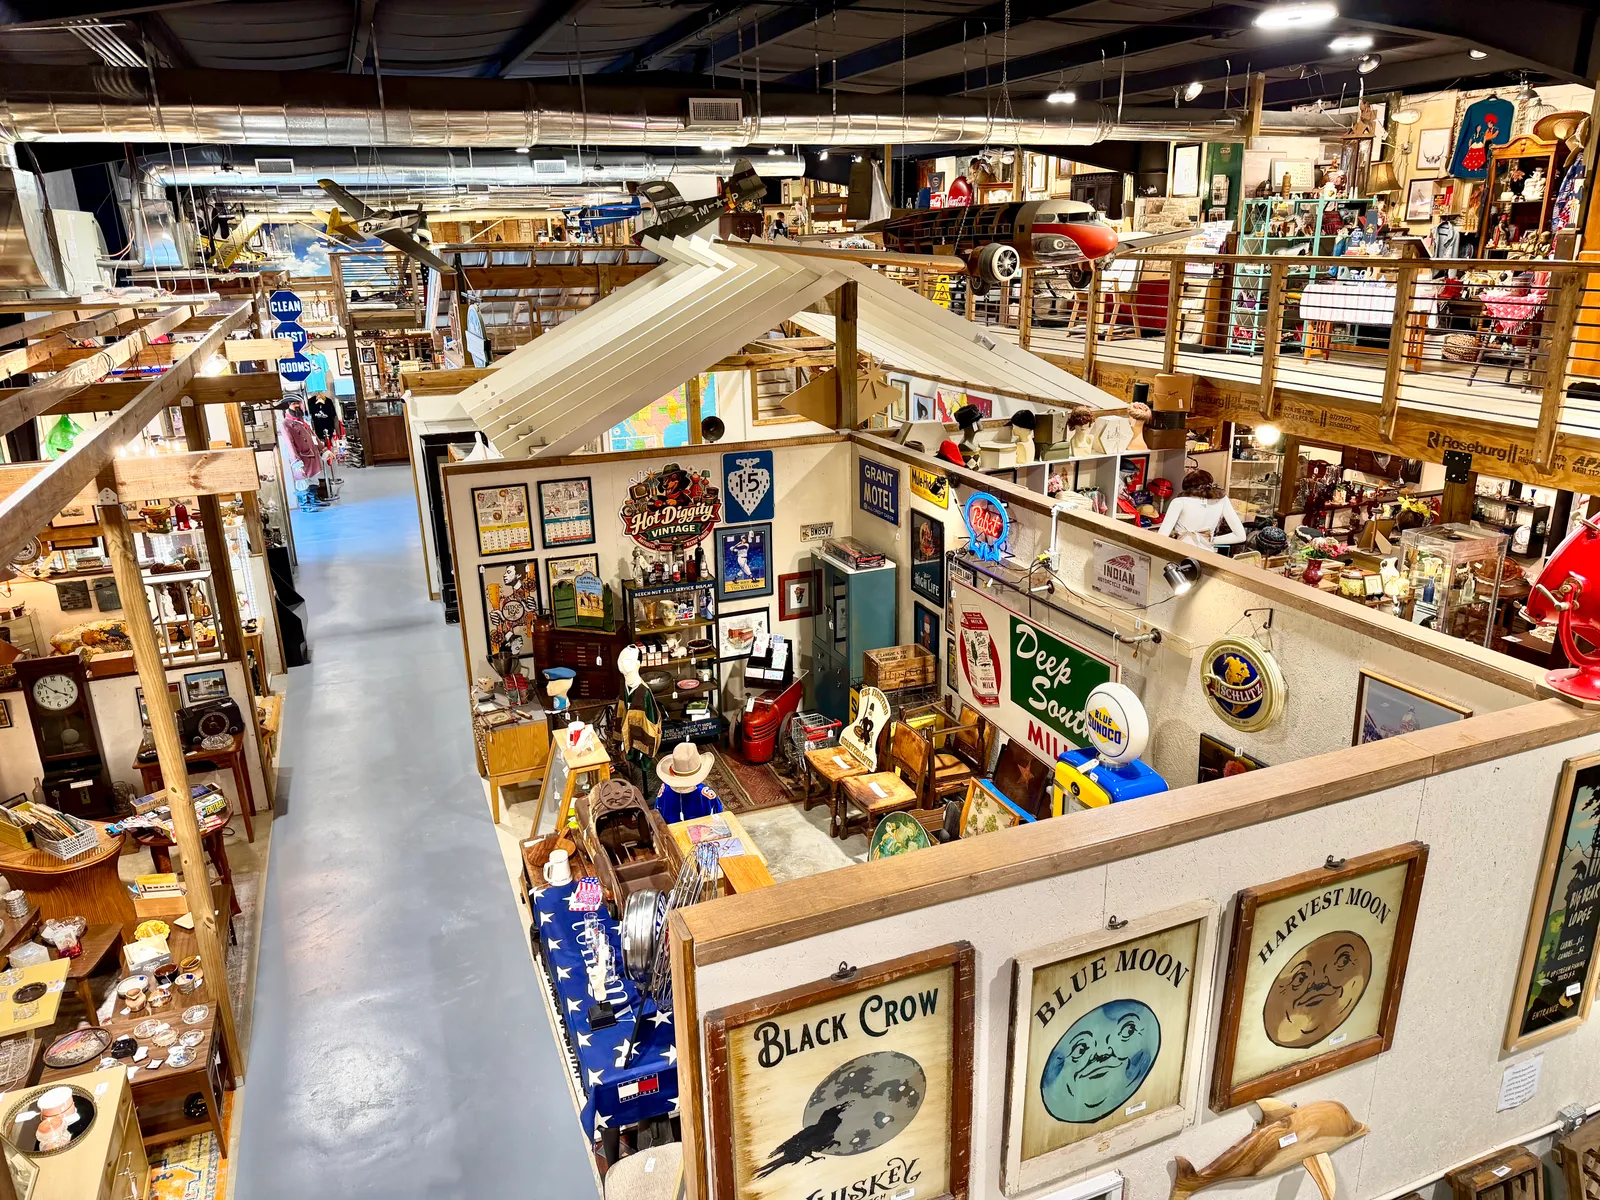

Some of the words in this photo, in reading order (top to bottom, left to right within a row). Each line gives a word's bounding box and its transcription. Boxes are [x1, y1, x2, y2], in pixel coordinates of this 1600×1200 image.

[271, 300, 301, 312] CLEAN
[277, 331, 304, 342] REST
[280, 361, 311, 373] ROOMS
[1442, 435, 1507, 461] Roseburg
[738, 472, 760, 493] 15
[864, 464, 894, 486] GRANT
[911, 468, 932, 490] Mule-Hid
[864, 483, 895, 514] MOTEL
[630, 510, 661, 536] Hot
[661, 502, 715, 525] Diggity
[971, 505, 1002, 536] Pabst
[651, 524, 696, 538] VINTAGE
[1103, 564, 1135, 586] INDIAN
[634, 588, 662, 598] BEECH-NUT
[675, 584, 695, 592] SERVICE
[1097, 576, 1121, 590] MOTORCYCLE
[1122, 585, 1141, 597] COMPANY
[1015, 623, 1072, 689] Deep
[982, 681, 995, 689] MILK
[1220, 682, 1263, 701] SCHLITZ
[1087, 713, 1122, 745] SUNOCO
[1094, 709, 1113, 727] BLUE
[1027, 720, 1068, 761] MIL
[205, 799, 226, 815] FOOTBALL
[1569, 888, 1582, 910] BIG
[1581, 881, 1600, 905] BEAR
[1257, 887, 1345, 965] HARVEST
[1345, 887, 1393, 925] MOON
[1567, 905, 1594, 928] LODGE
[1034, 956, 1108, 1029] BLUE
[1114, 947, 1191, 989] MOON
[1531, 1003, 1560, 1021] ENTRANCE
[753, 1012, 849, 1068] BLACK
[859, 987, 940, 1038] CROW
